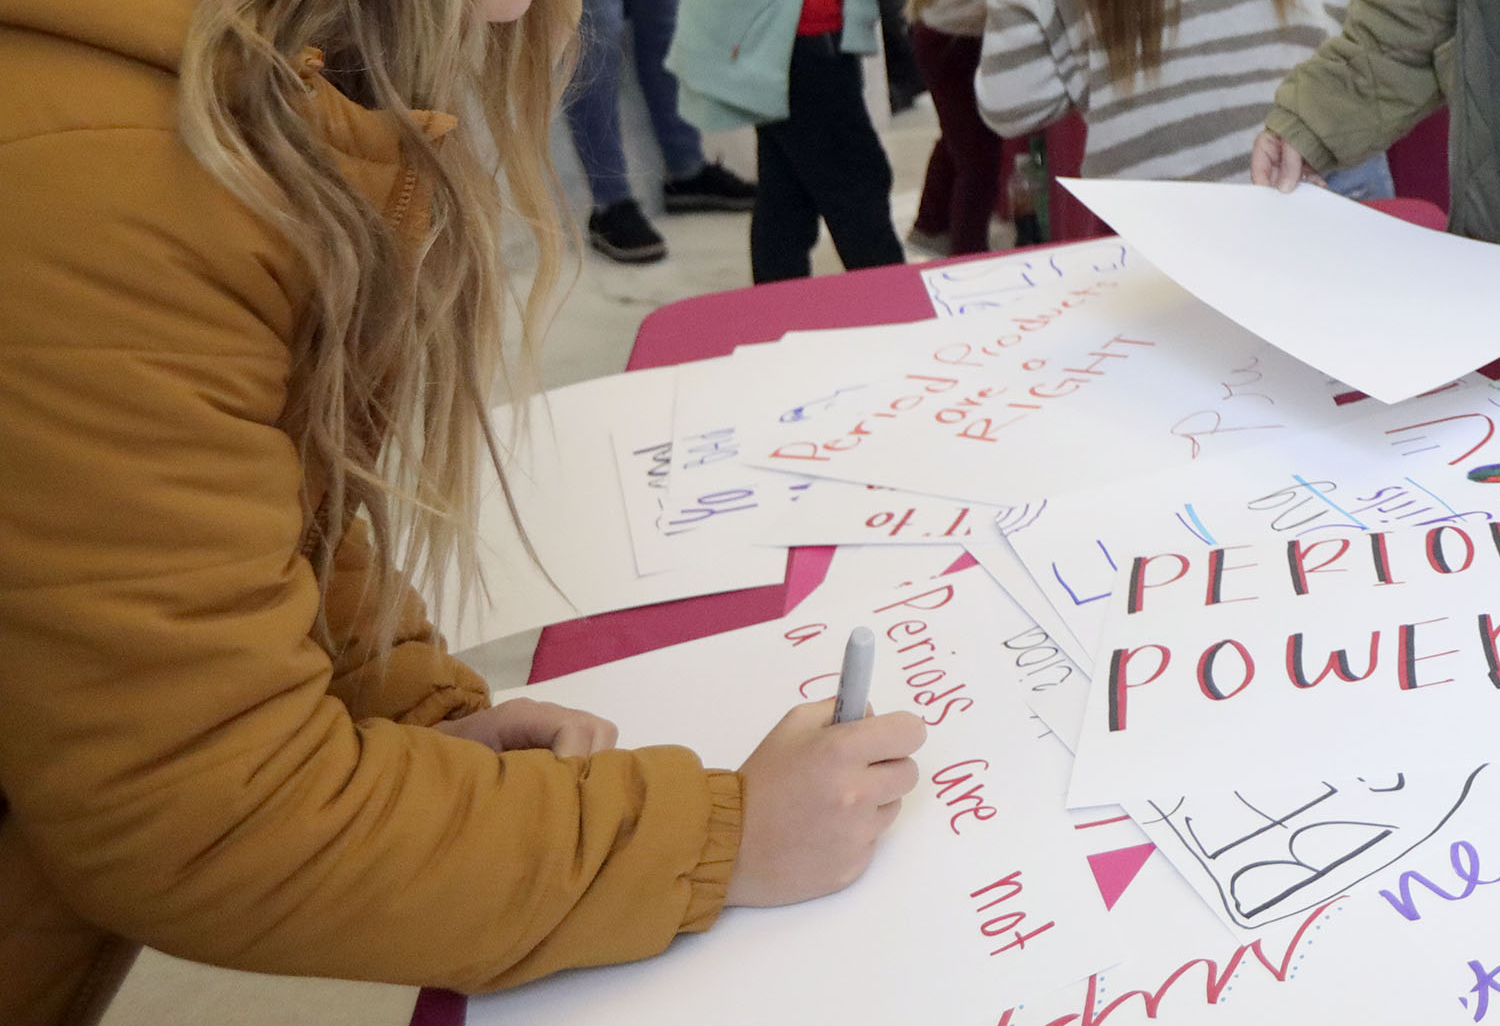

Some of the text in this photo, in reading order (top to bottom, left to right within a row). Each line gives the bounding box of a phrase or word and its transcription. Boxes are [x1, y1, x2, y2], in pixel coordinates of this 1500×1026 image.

[768, 373, 959, 462] Period
[934, 386, 1008, 425] are
[955, 333, 1157, 443] RIGHT
[873, 583, 1056, 956] Periods are not
